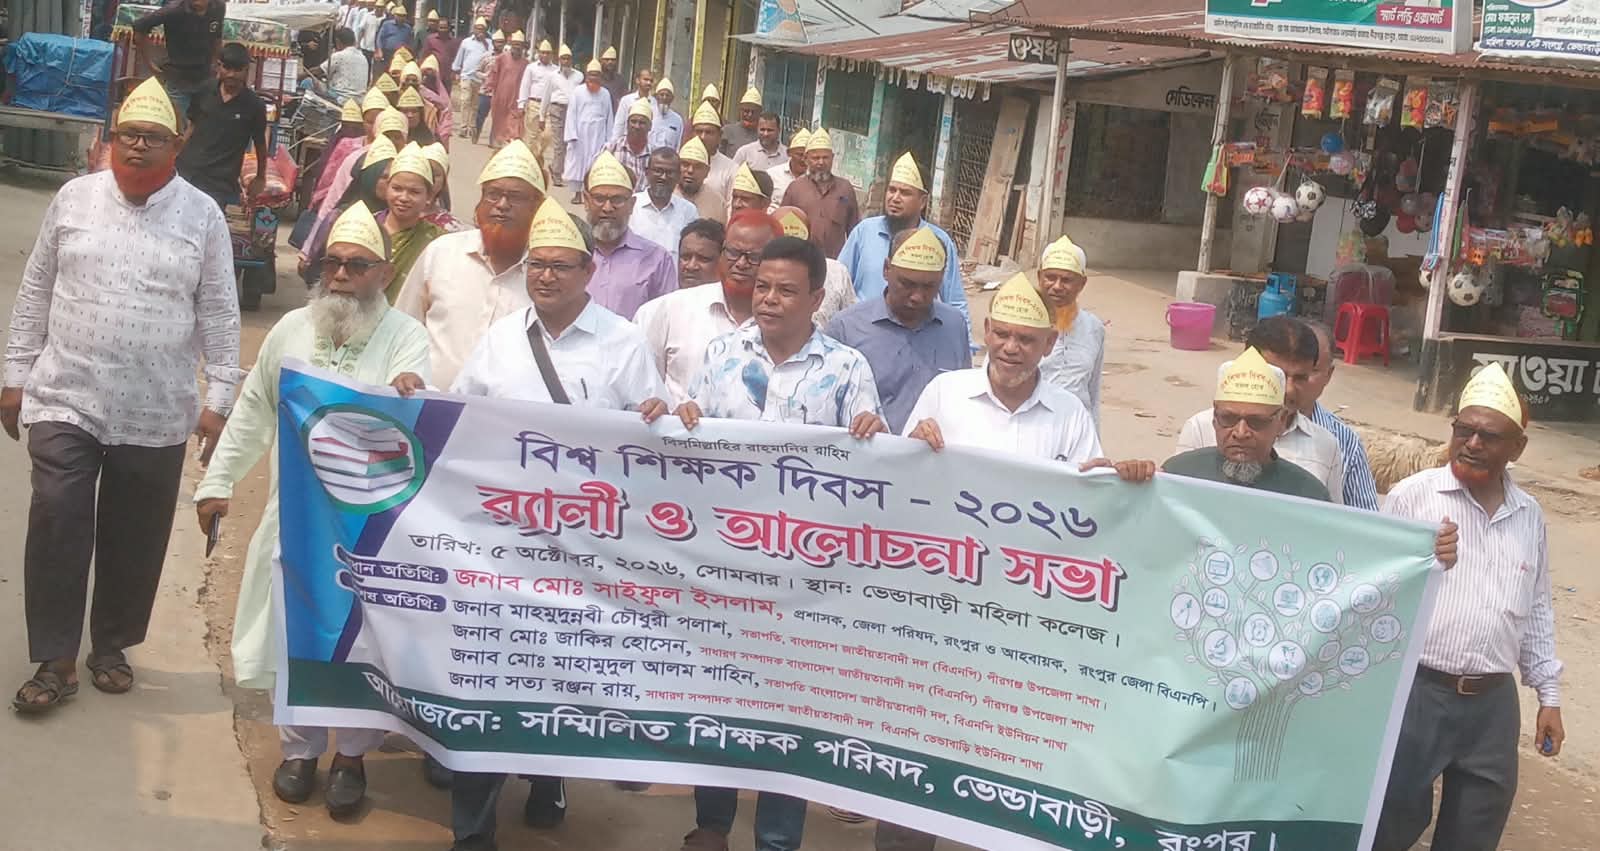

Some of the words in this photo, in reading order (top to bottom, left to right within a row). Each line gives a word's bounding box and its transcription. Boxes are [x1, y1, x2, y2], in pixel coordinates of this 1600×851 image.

[514, 431, 601, 475] বিশ্ব
[616, 445, 762, 490] শিক্ষক
[772, 455, 893, 511] দিবস
[954, 490, 1098, 541] ২০২৬
[815, 446, 850, 461] রাহিম
[380, 563, 440, 581] অতিথি:
[382, 592, 439, 610] অতিথি:
[408, 533, 481, 555] তারিখ:
[491, 545, 510, 560] ৫
[515, 545, 604, 572] অক্টোবর,
[616, 557, 685, 580] ২০২৬,
[801, 577, 852, 595] স্থান:
[862, 584, 962, 614] ভেন্ডাবাড়ী
[969, 601, 1031, 628] মহিলা
[646, 501, 697, 541] ও
[712, 505, 989, 586] আলোচনা
[1000, 546, 1127, 612] সভা
[452, 599, 503, 617] জনাব
[509, 602, 603, 626] মাহমুদুন্নবী
[611, 605, 670, 630] চৌধুরী
[677, 615, 732, 639] পলাশ,
[790, 636, 838, 653] বাংলাদেশ
[842, 644, 908, 665] জাতীয়তাবাদী
[912, 658, 928, 670] দল
[933, 661, 982, 682] (বিএনপি)
[987, 671, 1023, 690] পীরগঞ্জ
[1027, 680, 1072, 702] উপজেলা
[452, 624, 502, 642] জনাব
[510, 630, 548, 646] মোঃ
[555, 631, 616, 648] জাকির
[622, 635, 691, 656] হোসেন,
[699, 646, 736, 660] সাধারণ
[741, 653, 784, 665] সম্পাদক
[787, 660, 834, 676] বাংলাদেশ
[838, 666, 904, 689] জাতীয়তাবাদী
[908, 682, 924, 693] দল
[929, 685, 977, 706] (বিএনপি)
[983, 696, 1019, 714] পীরগঞ্জ
[1023, 706, 1068, 727] উপজেলা
[1072, 718, 1095, 734] শাখা
[453, 568, 520, 592] জনাব
[533, 576, 584, 596] মোঃ
[592, 581, 682, 608] সাইফুল
[689, 585, 783, 621] ইসলাম,
[793, 608, 846, 630] প্রশাসক,
[852, 617, 886, 635] জেলা
[891, 624, 938, 646] পরিষদ,
[944, 635, 980, 653] রংপুর
[985, 644, 996, 655] ও
[1079, 663, 1117, 684] রংপুর
[1121, 674, 1153, 694] জেলা
[449, 672, 500, 690] জনাব
[505, 676, 546, 693] সত্য
[552, 680, 595, 697] রঞ্জন
[601, 682, 640, 702] রায়,
[645, 689, 684, 701] সাধারণ
[688, 692, 732, 705] সম্পাদক
[736, 698, 784, 712] বাংলাদেশ
[788, 704, 854, 725] জাতীয়তাবাদী
[857, 718, 874, 729] দল
[881, 722, 920, 741] বিএনপি
[924, 733, 970, 753] ভেন্ডাবাড়ি
[974, 743, 1016, 764] ইউনিয়ন
[1020, 757, 1044, 772] শাখা
[450, 648, 501, 666] জনাব
[508, 653, 546, 669] মোঃ
[551, 656, 636, 679] মাহামুদুল
[641, 660, 696, 678] আলম
[701, 663, 759, 688] শাহিন,
[764, 677, 806, 692] সভাপতি
[810, 685, 857, 703] বাংলাদেশ
[861, 695, 927, 717] জাতীয়তাবাদী
[954, 714, 993, 733] বিএনপি
[997, 723, 1039, 744] ইউনিয়ন
[1043, 737, 1067, 752] শাখা
[518, 705, 675, 742] সম্মিলিত
[684, 713, 802, 754] শিক্ষক
[814, 732, 935, 793] পরিষদ,
[954, 773, 1127, 848] ভেন্ডাবাড়ী,
